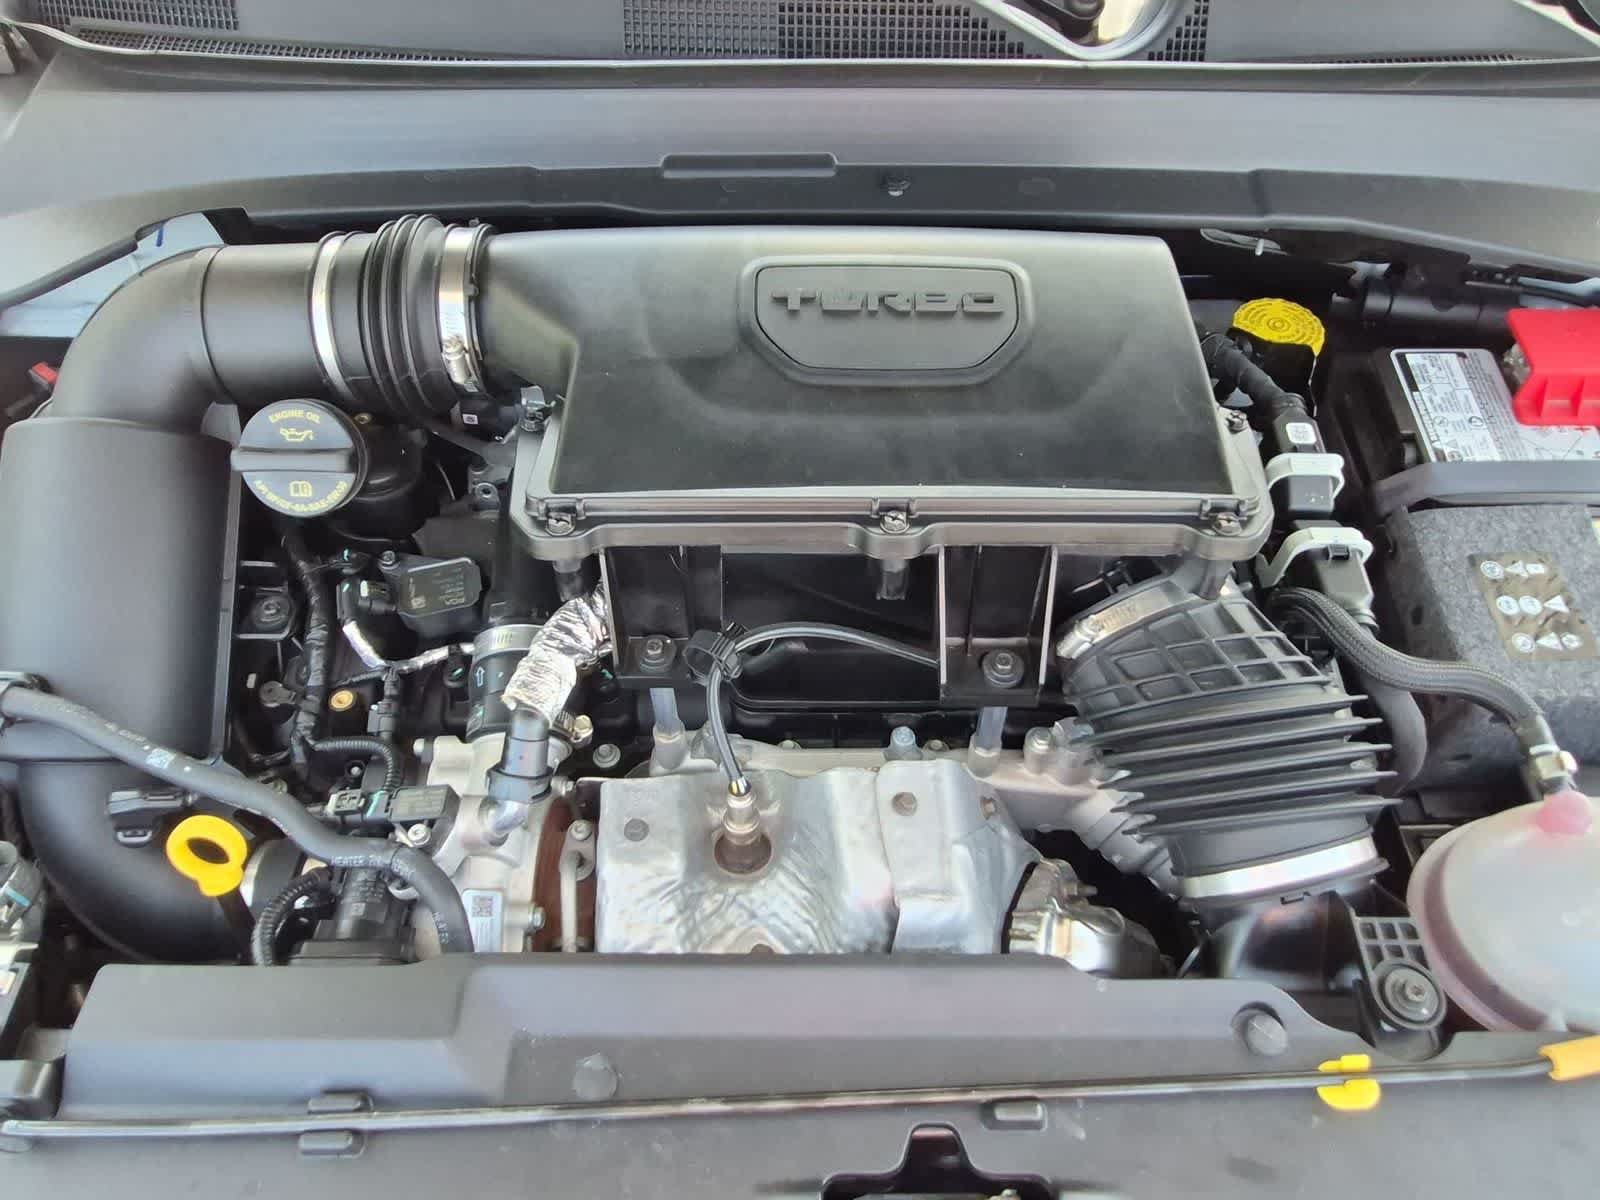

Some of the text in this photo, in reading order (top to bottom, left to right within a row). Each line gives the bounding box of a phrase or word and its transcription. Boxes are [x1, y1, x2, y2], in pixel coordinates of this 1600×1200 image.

[771, 289, 1004, 313] TURBO
[269, 409, 320, 424] ENGINE OIL
